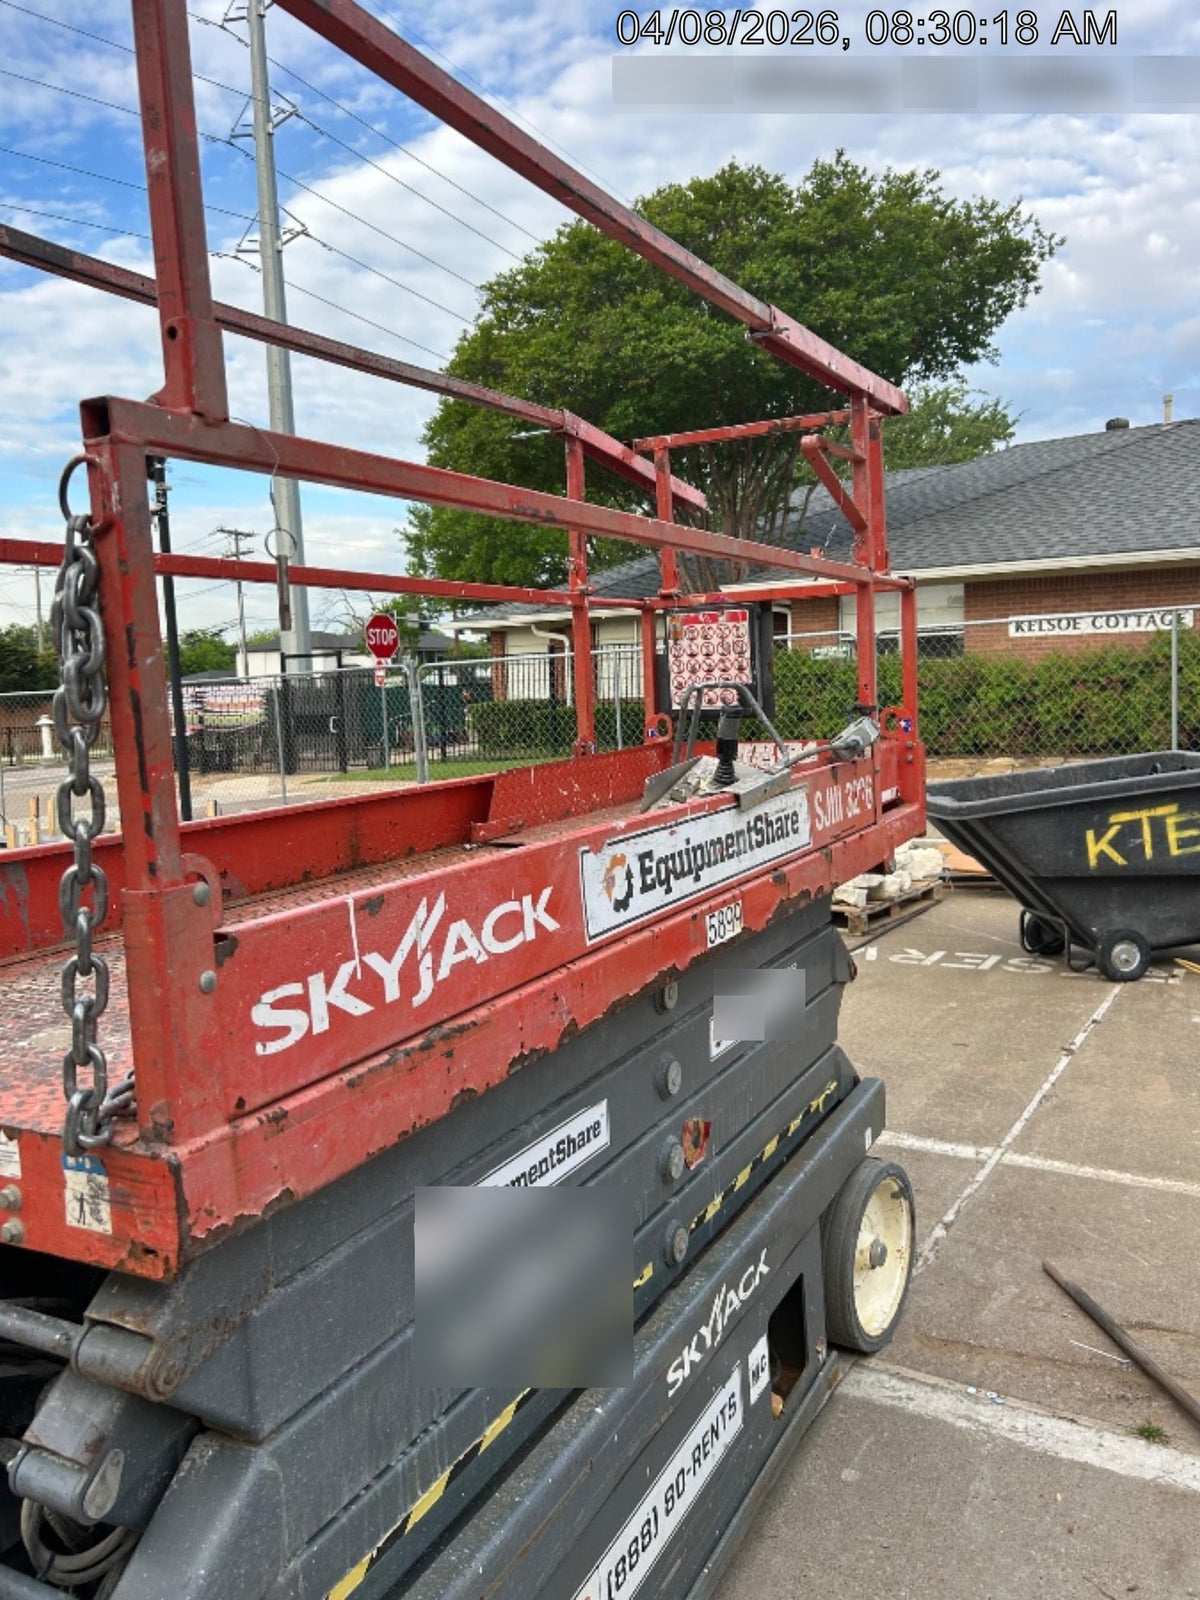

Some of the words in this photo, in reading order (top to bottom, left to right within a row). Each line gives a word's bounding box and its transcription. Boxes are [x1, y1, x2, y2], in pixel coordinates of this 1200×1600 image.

[368, 628, 397, 646] STOP
[638, 810, 799, 894] EquipmentShare
[1086, 804, 1200, 870] KTE
[709, 902, 741, 945] 5899
[251, 886, 561, 1056] SKYJACK
[666, 1248, 771, 1398] SKYJACK
